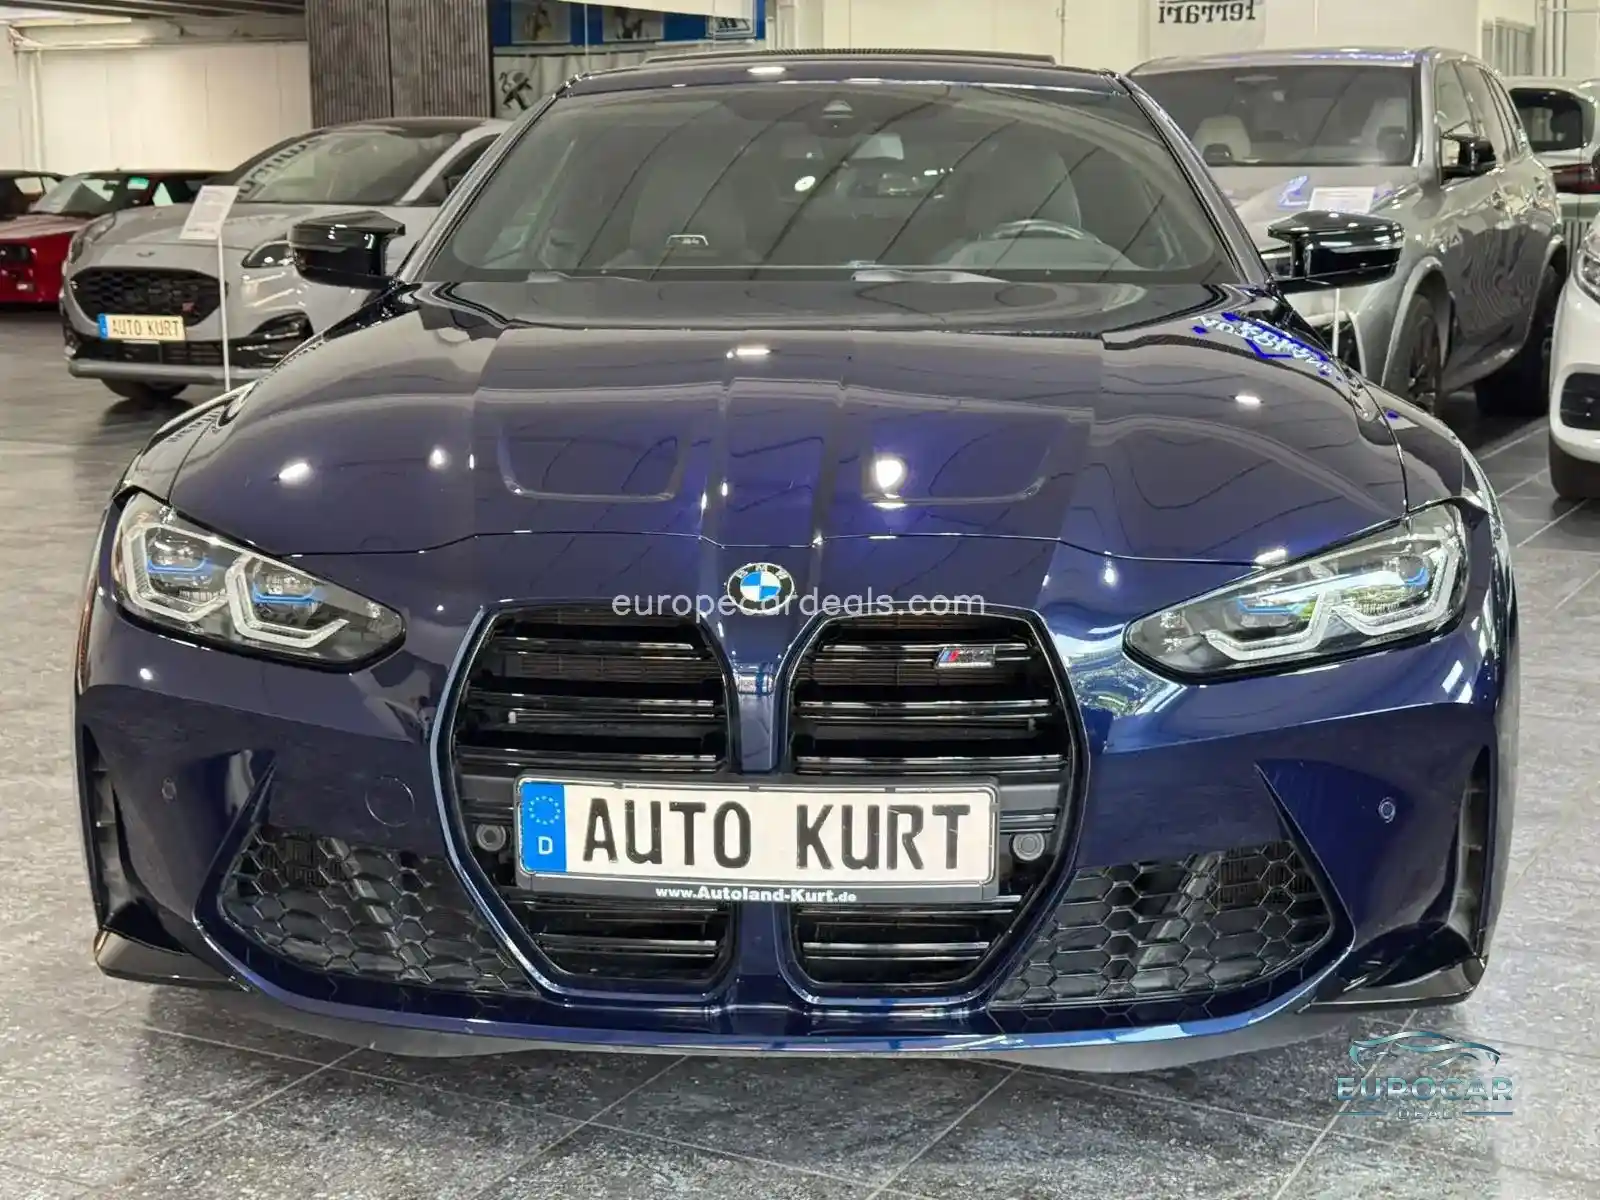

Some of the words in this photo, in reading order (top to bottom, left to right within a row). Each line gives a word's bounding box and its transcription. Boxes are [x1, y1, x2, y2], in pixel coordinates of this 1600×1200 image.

[111, 319, 142, 336] AUTO
[147, 320, 180, 337] KURT
[537, 835, 554, 856] D
[582, 797, 752, 869] AUTO
[795, 803, 971, 871] KURT
[654, 885, 858, 903] www.Autoland-Kurt.de
